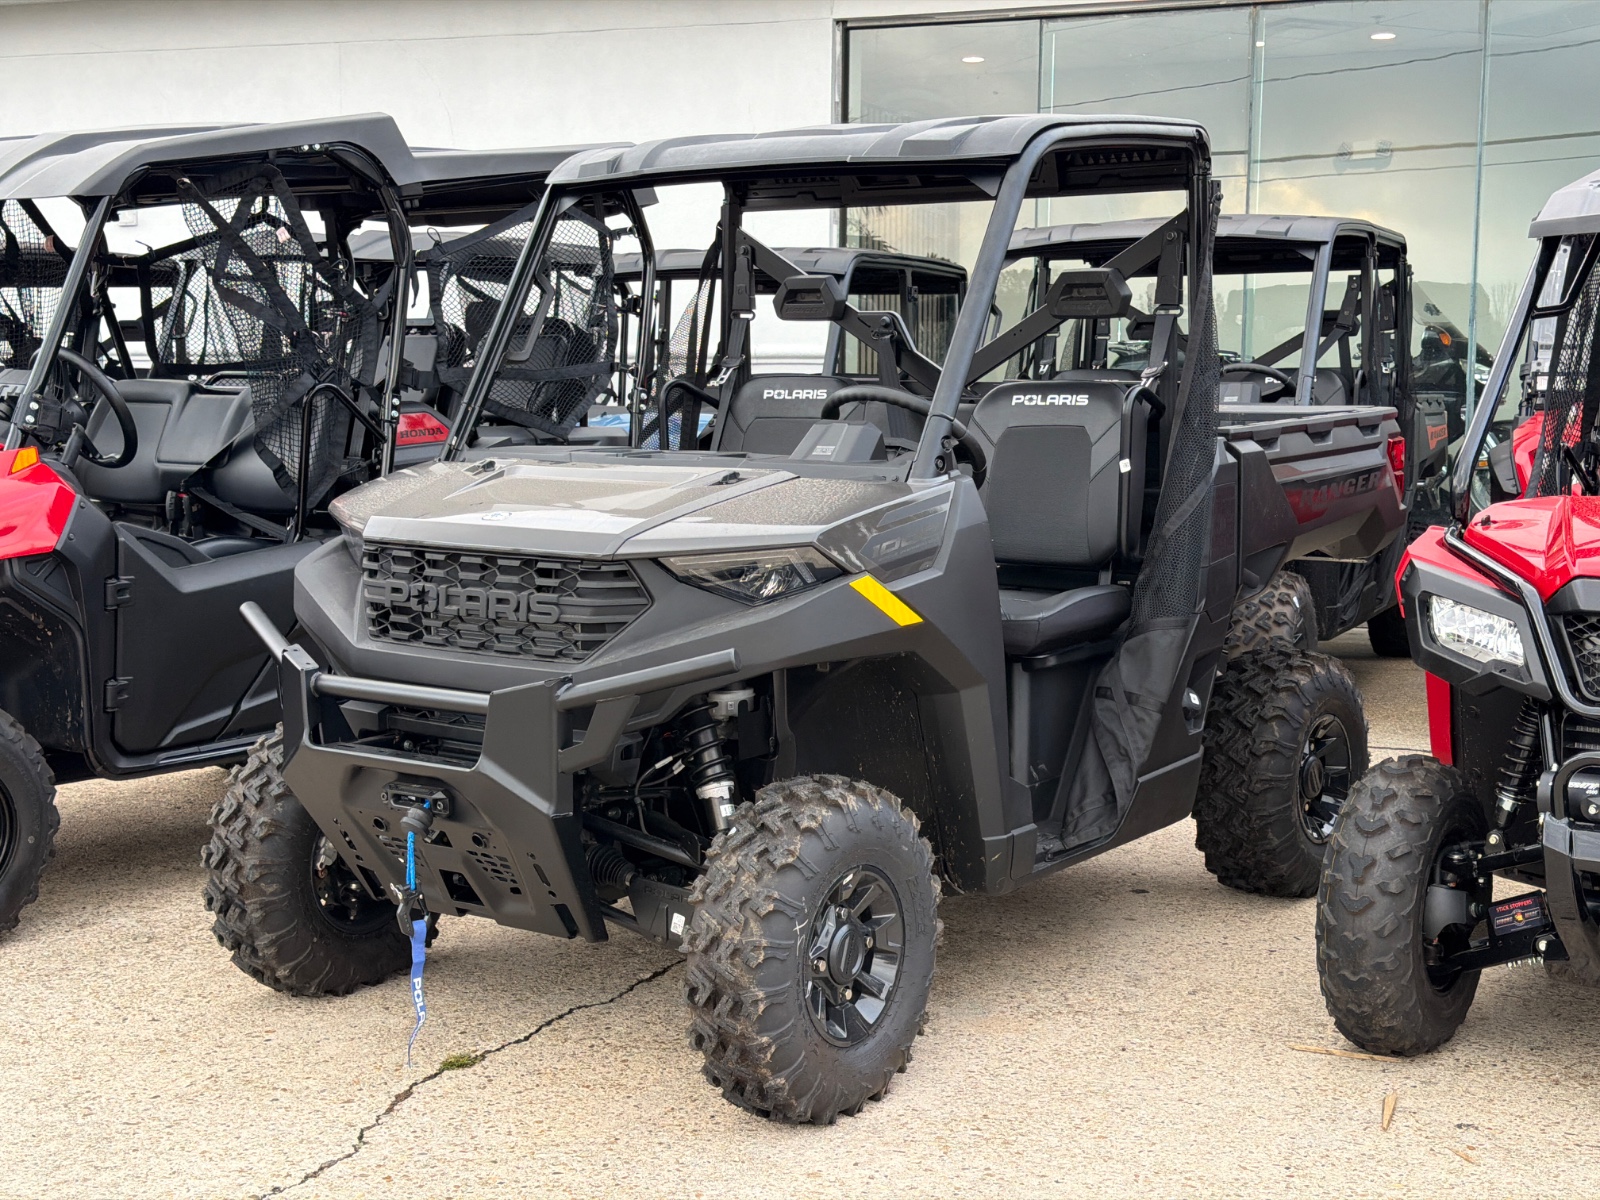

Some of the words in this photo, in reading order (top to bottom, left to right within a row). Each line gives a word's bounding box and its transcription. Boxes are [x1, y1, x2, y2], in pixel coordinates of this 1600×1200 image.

[763, 389, 828, 400] POLARIS
[1011, 394, 1089, 406] POLARIS
[399, 427, 444, 439] HONDA
[1299, 470, 1380, 508] RANGER
[384, 578, 560, 625] POLARIS
